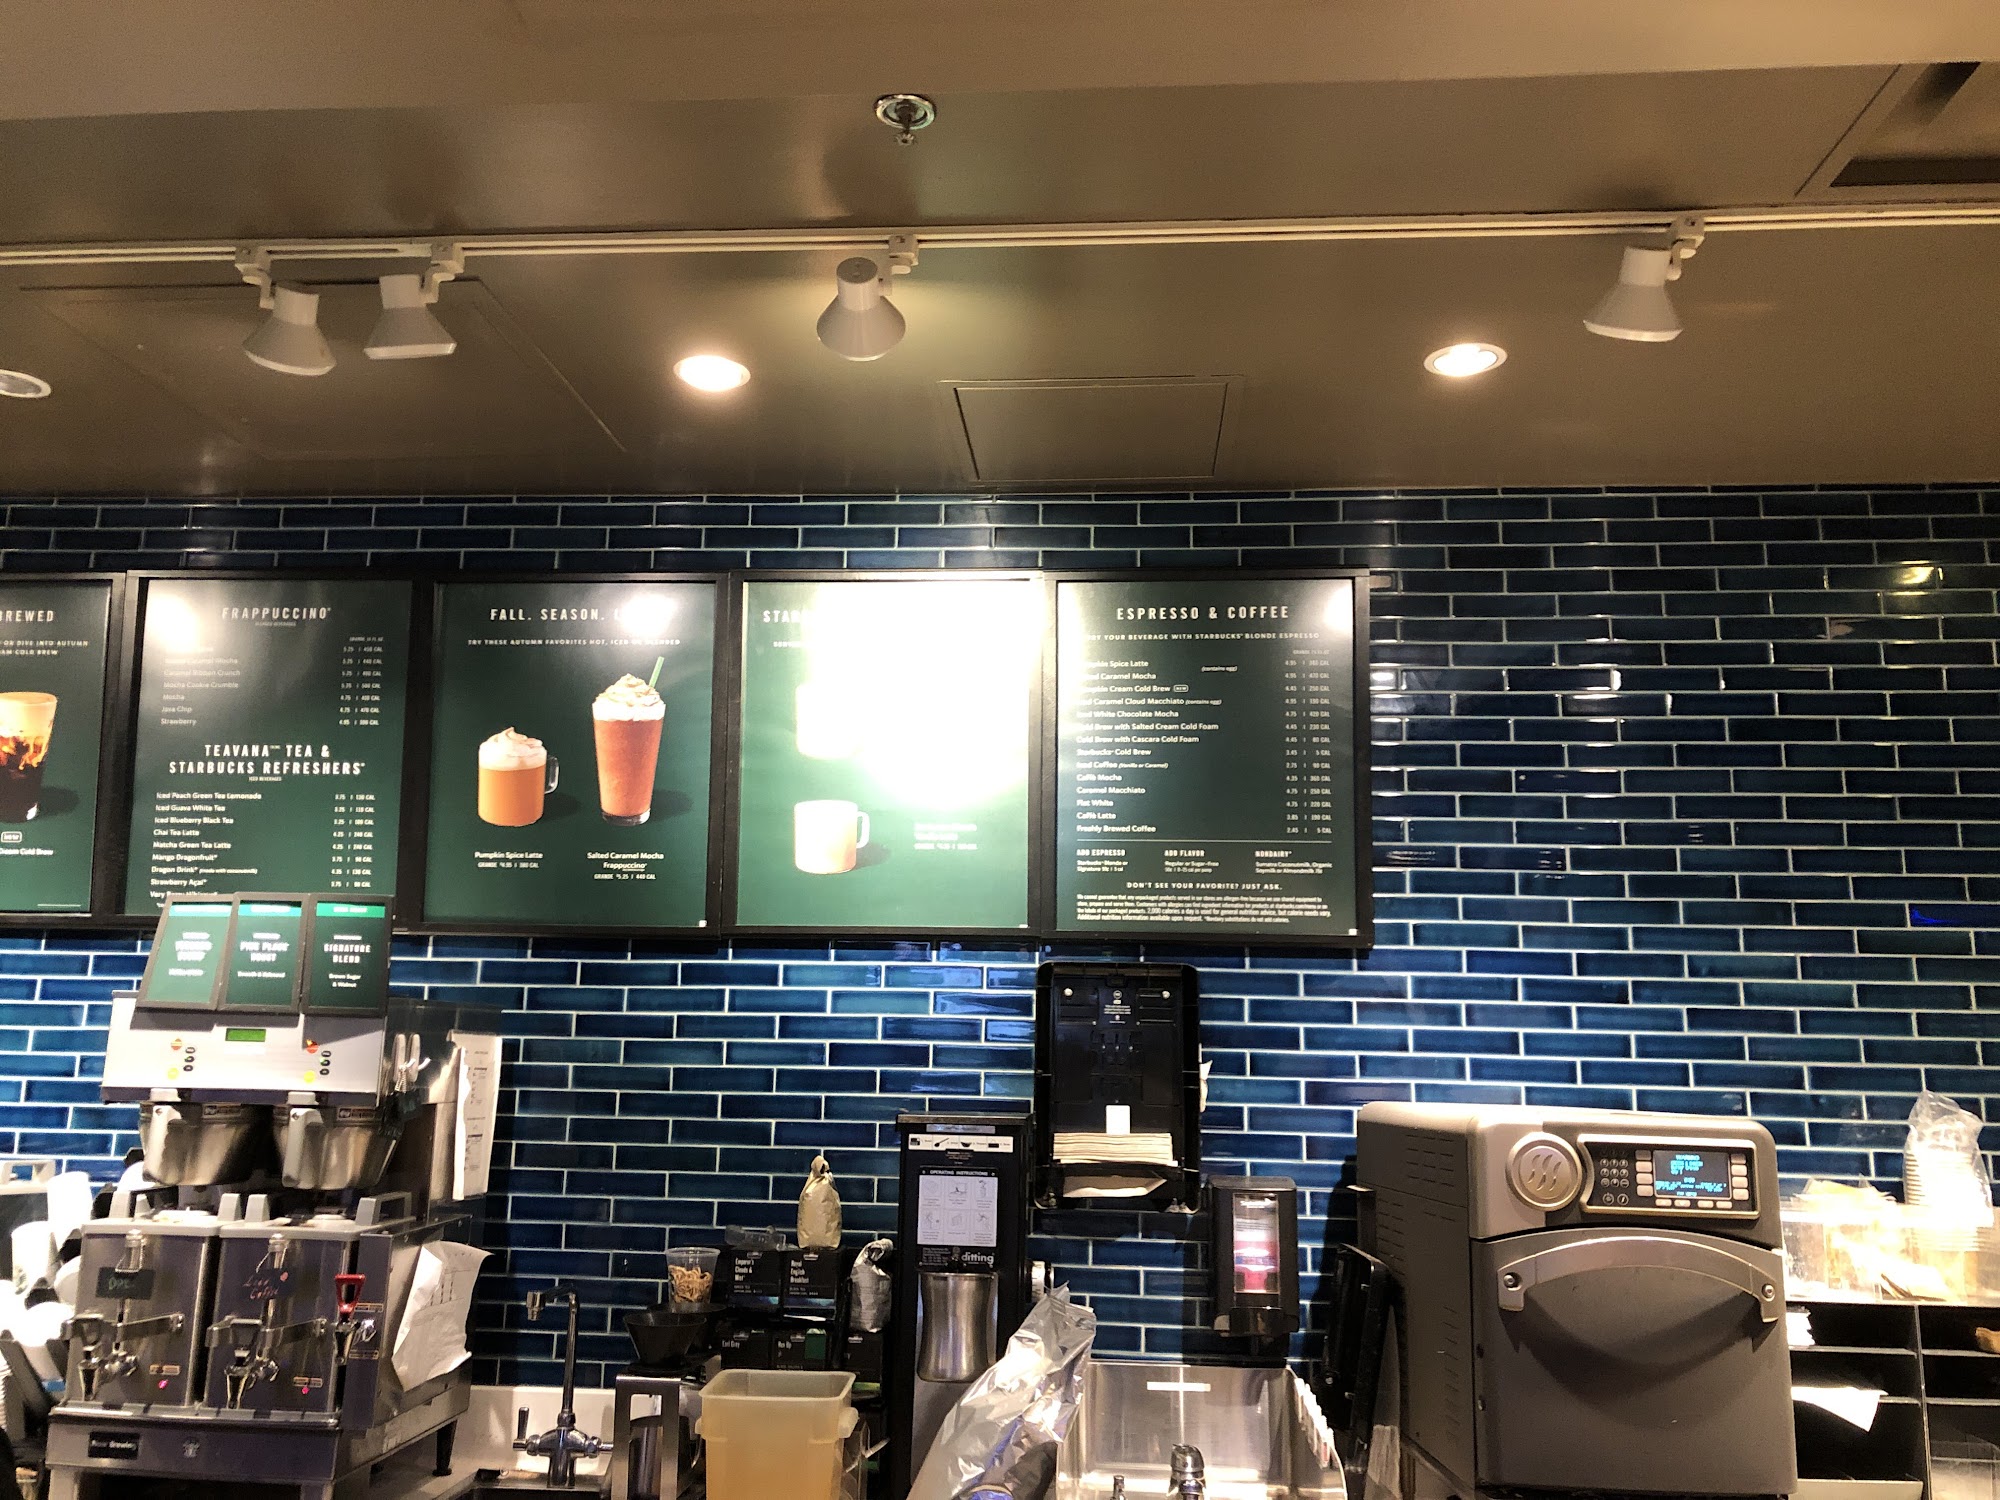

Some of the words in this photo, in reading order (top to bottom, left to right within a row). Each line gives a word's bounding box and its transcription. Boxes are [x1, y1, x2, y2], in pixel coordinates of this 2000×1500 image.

[490, 608, 532, 621] FALL.
[540, 608, 605, 621] SEASON.
[1117, 606, 1199, 620] ESPRESSO
[1208, 607, 1218, 619] &
[1228, 606, 1289, 619] COFFEE
[57, 640, 89, 648] AUTUMN
[589, 639, 608, 647] HOT,
[15, 649, 35, 657] COLD
[37, 649, 59, 657] BREW
[160, 718, 197, 726] Strawberry
[205, 744, 269, 757] TEAVANA
[285, 744, 313, 757] TEA
[320, 744, 330, 757] &
[169, 761, 255, 774] STARBUCKS
[156, 792, 171, 800] Iced
[172, 792, 191, 800] Peach
[192, 792, 213, 800] Green
[214, 792, 226, 800] Tea
[226, 792, 262, 800] Lemonade
[170, 817, 201, 825] Blueberry
[1076, 825, 1102, 833] Freshly
[474, 851, 505, 860] Pumpkin
[506, 851, 524, 860] Spice
[524, 851, 544, 859] Latte
[587, 852, 609, 860] Salted
[610, 852, 639, 860] Caramel
[640, 852, 665, 860] Mocha
[1091, 849, 1126, 857] ESPRESSO
[152, 854, 175, 862] Mango
[151, 866, 175, 874] Dragon
[150, 879, 187, 887] Strawberry
[324, 944, 371, 952] SIGNATURE
[333, 955, 360, 963] BLEND
[961, 1251, 994, 1265] ditting
[790, 1268, 805, 1276] English
